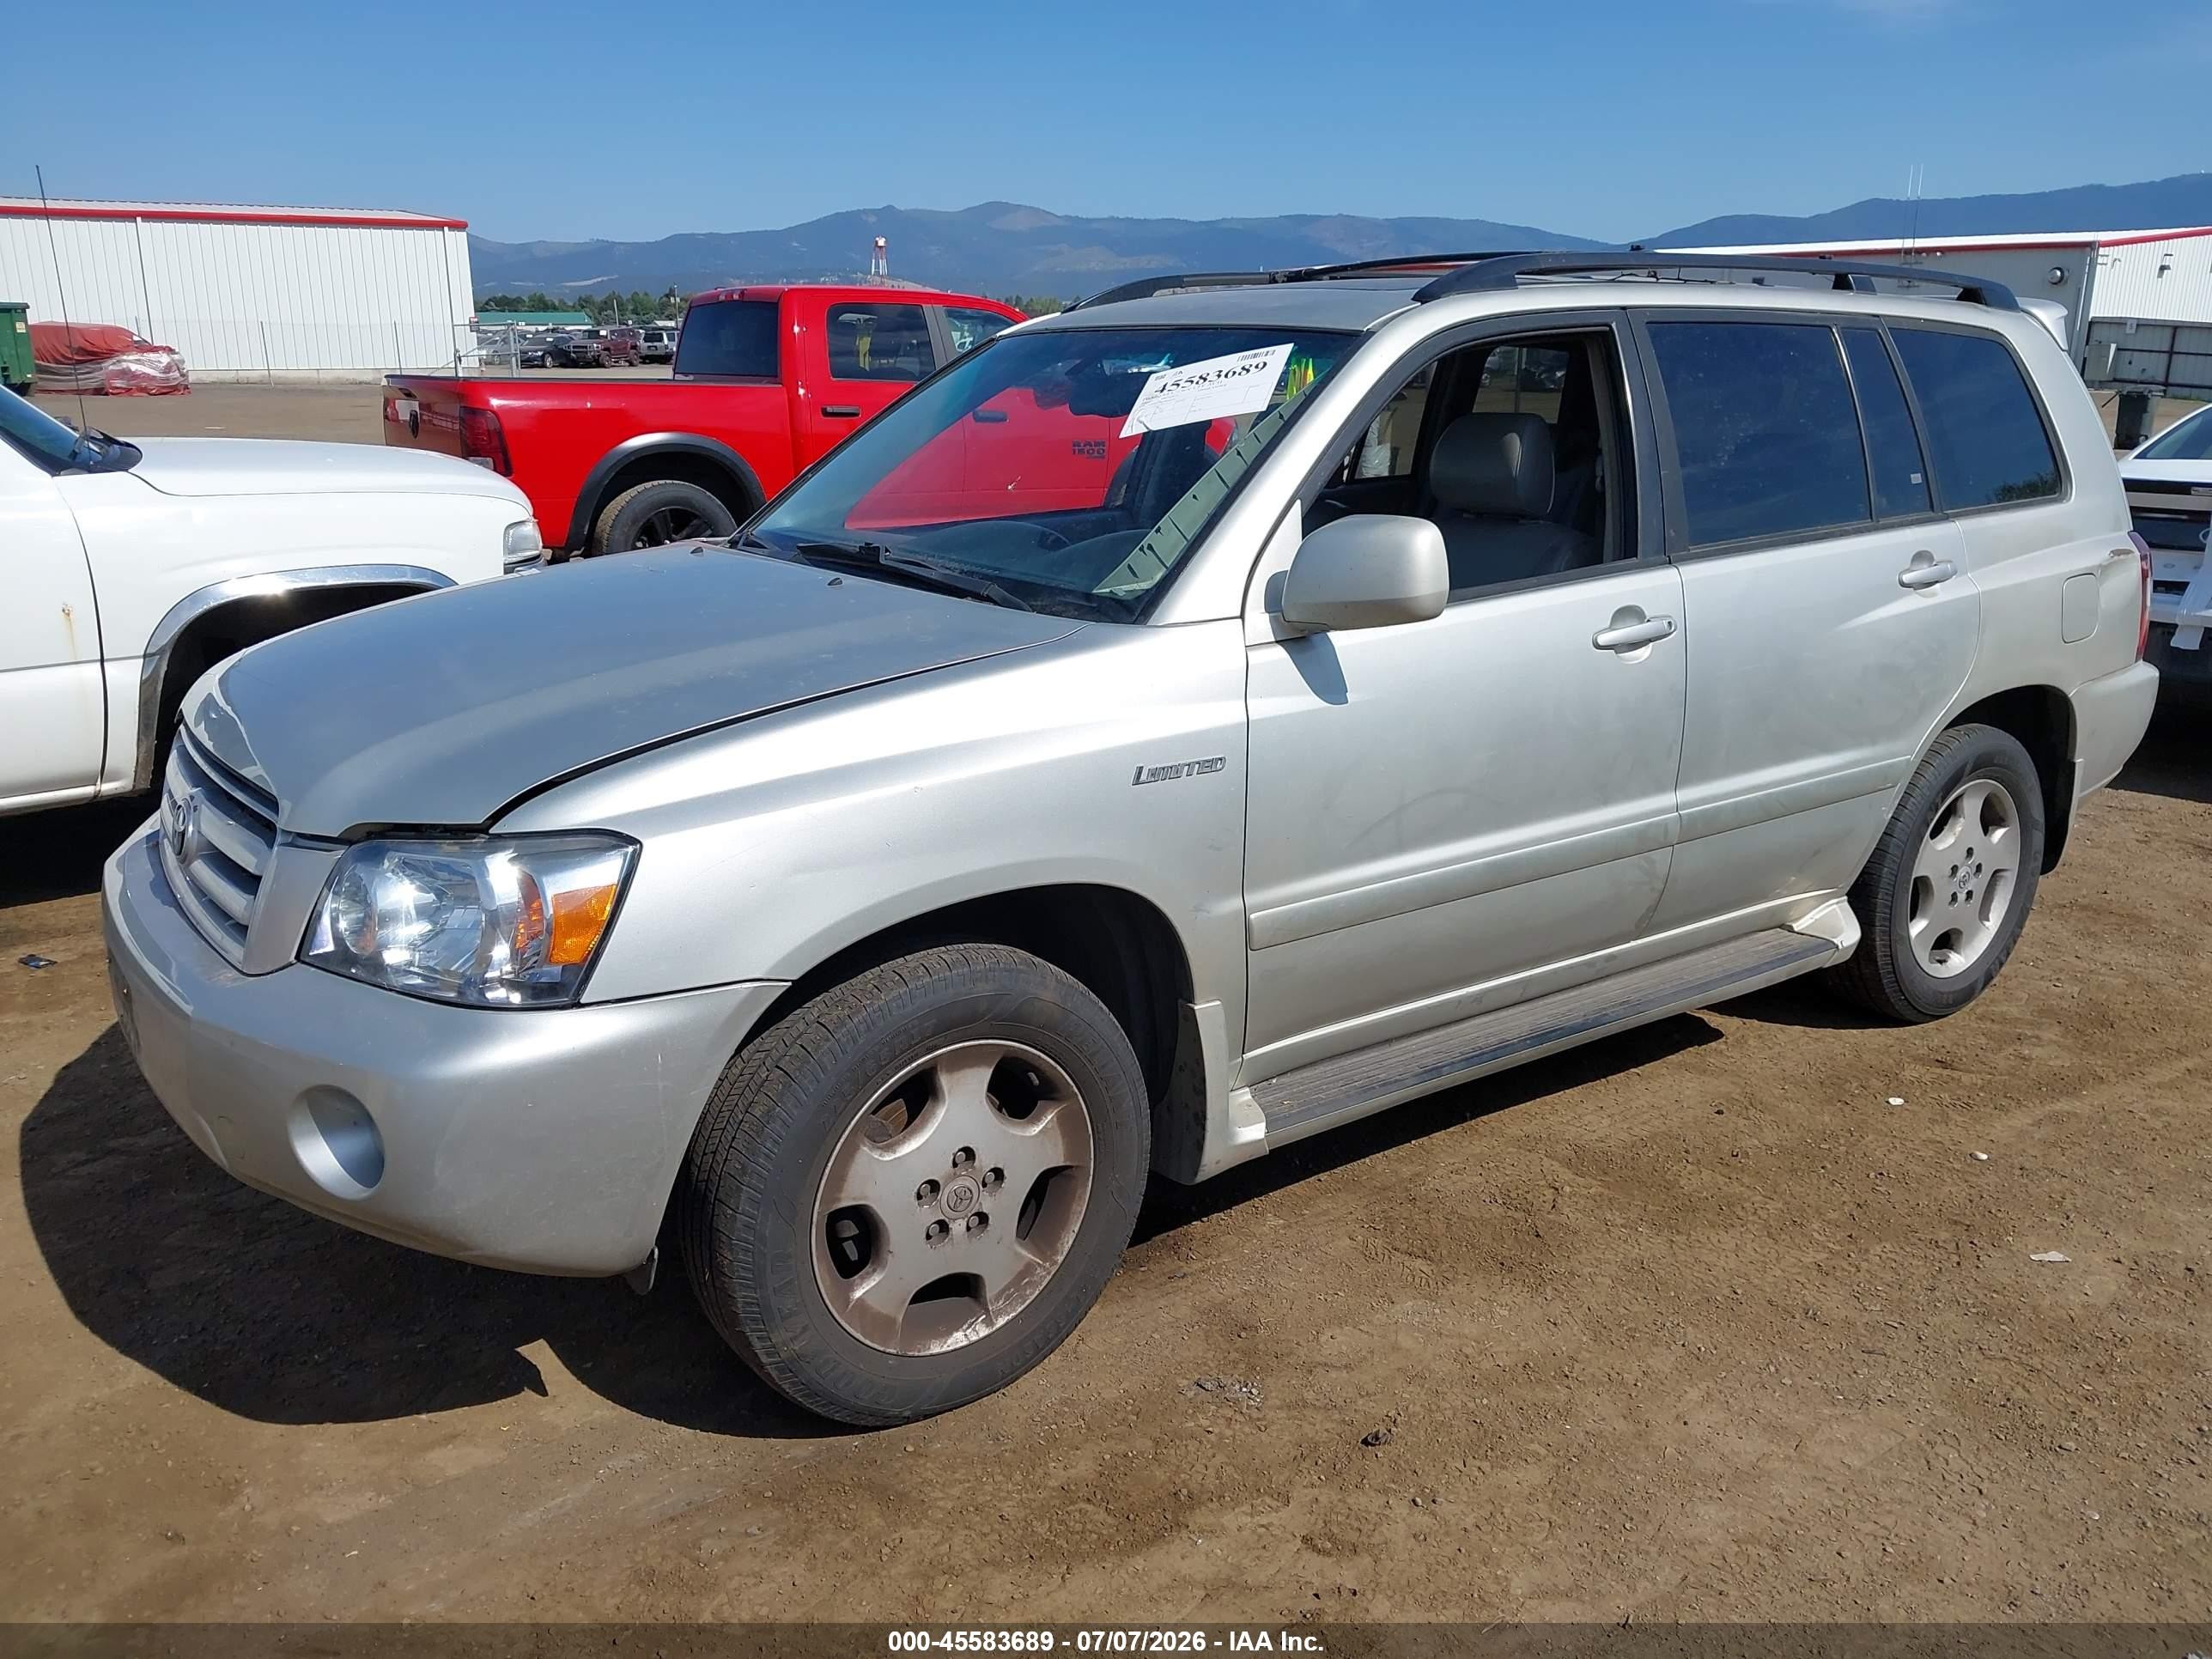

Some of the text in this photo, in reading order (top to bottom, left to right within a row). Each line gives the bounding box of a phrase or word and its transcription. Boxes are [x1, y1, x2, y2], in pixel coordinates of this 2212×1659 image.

[1154, 362, 1267, 393] 45583689
[1132, 757, 1226, 786] LIMITED
[771, 1245, 901, 1408] GOODYEAR
